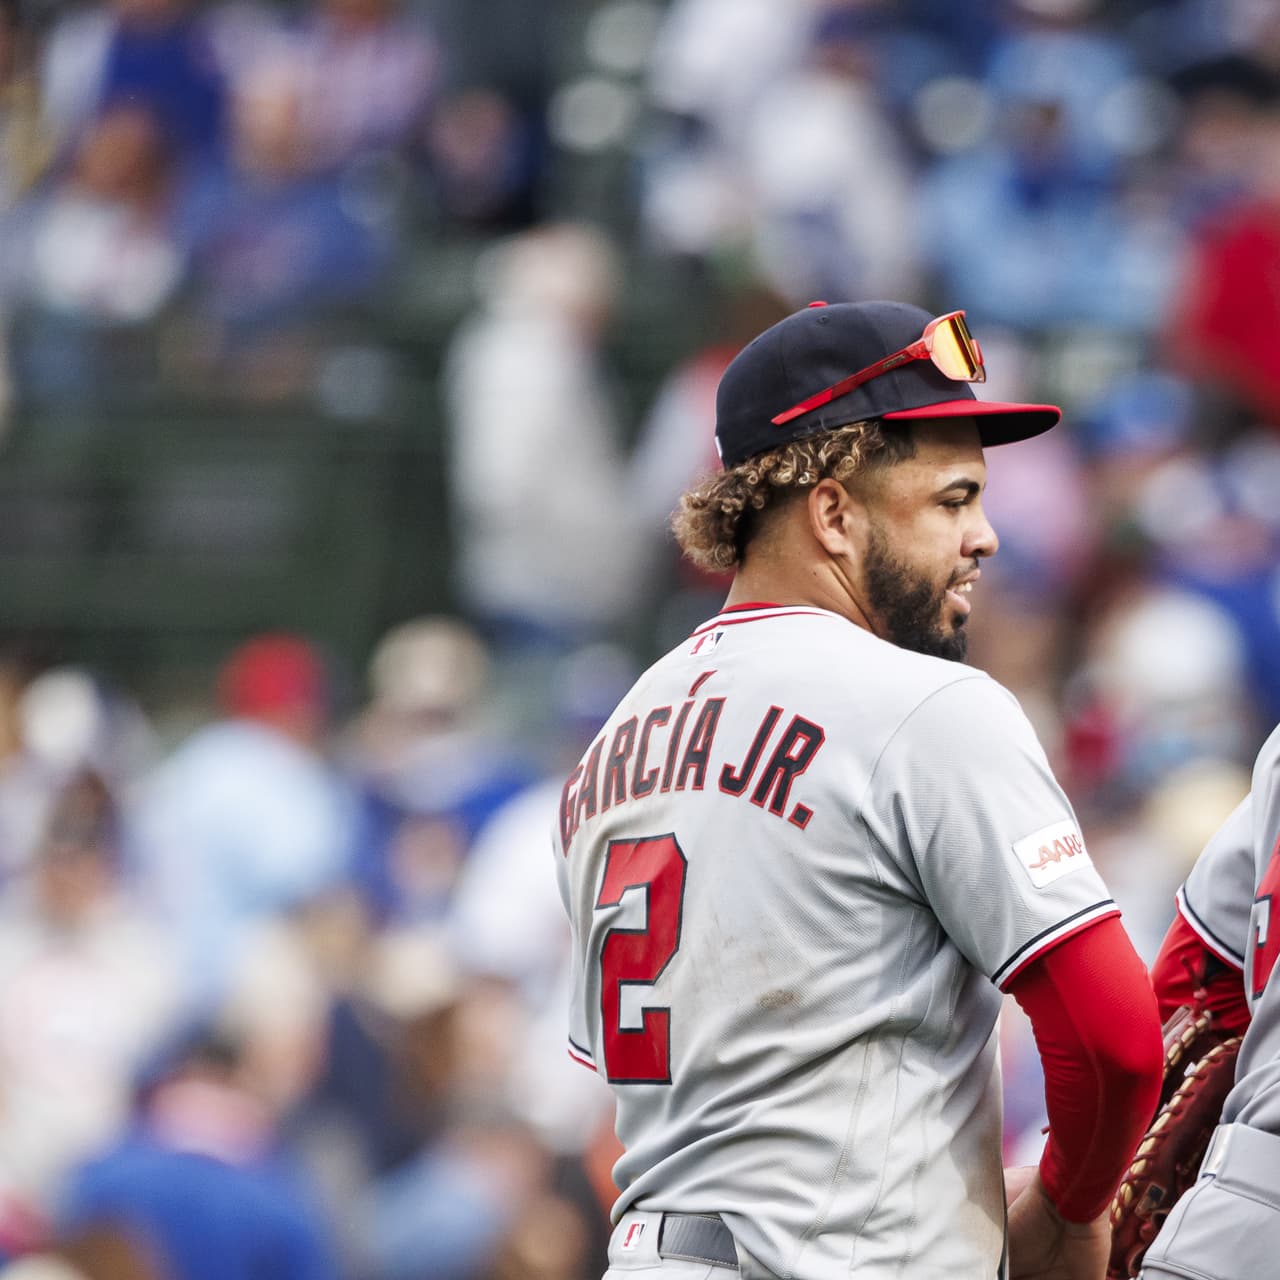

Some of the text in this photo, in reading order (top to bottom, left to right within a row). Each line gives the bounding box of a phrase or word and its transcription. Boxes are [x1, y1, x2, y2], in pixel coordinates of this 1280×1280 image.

[559, 669, 826, 858] GARCÍA JR.
[594, 831, 689, 1086] 2
